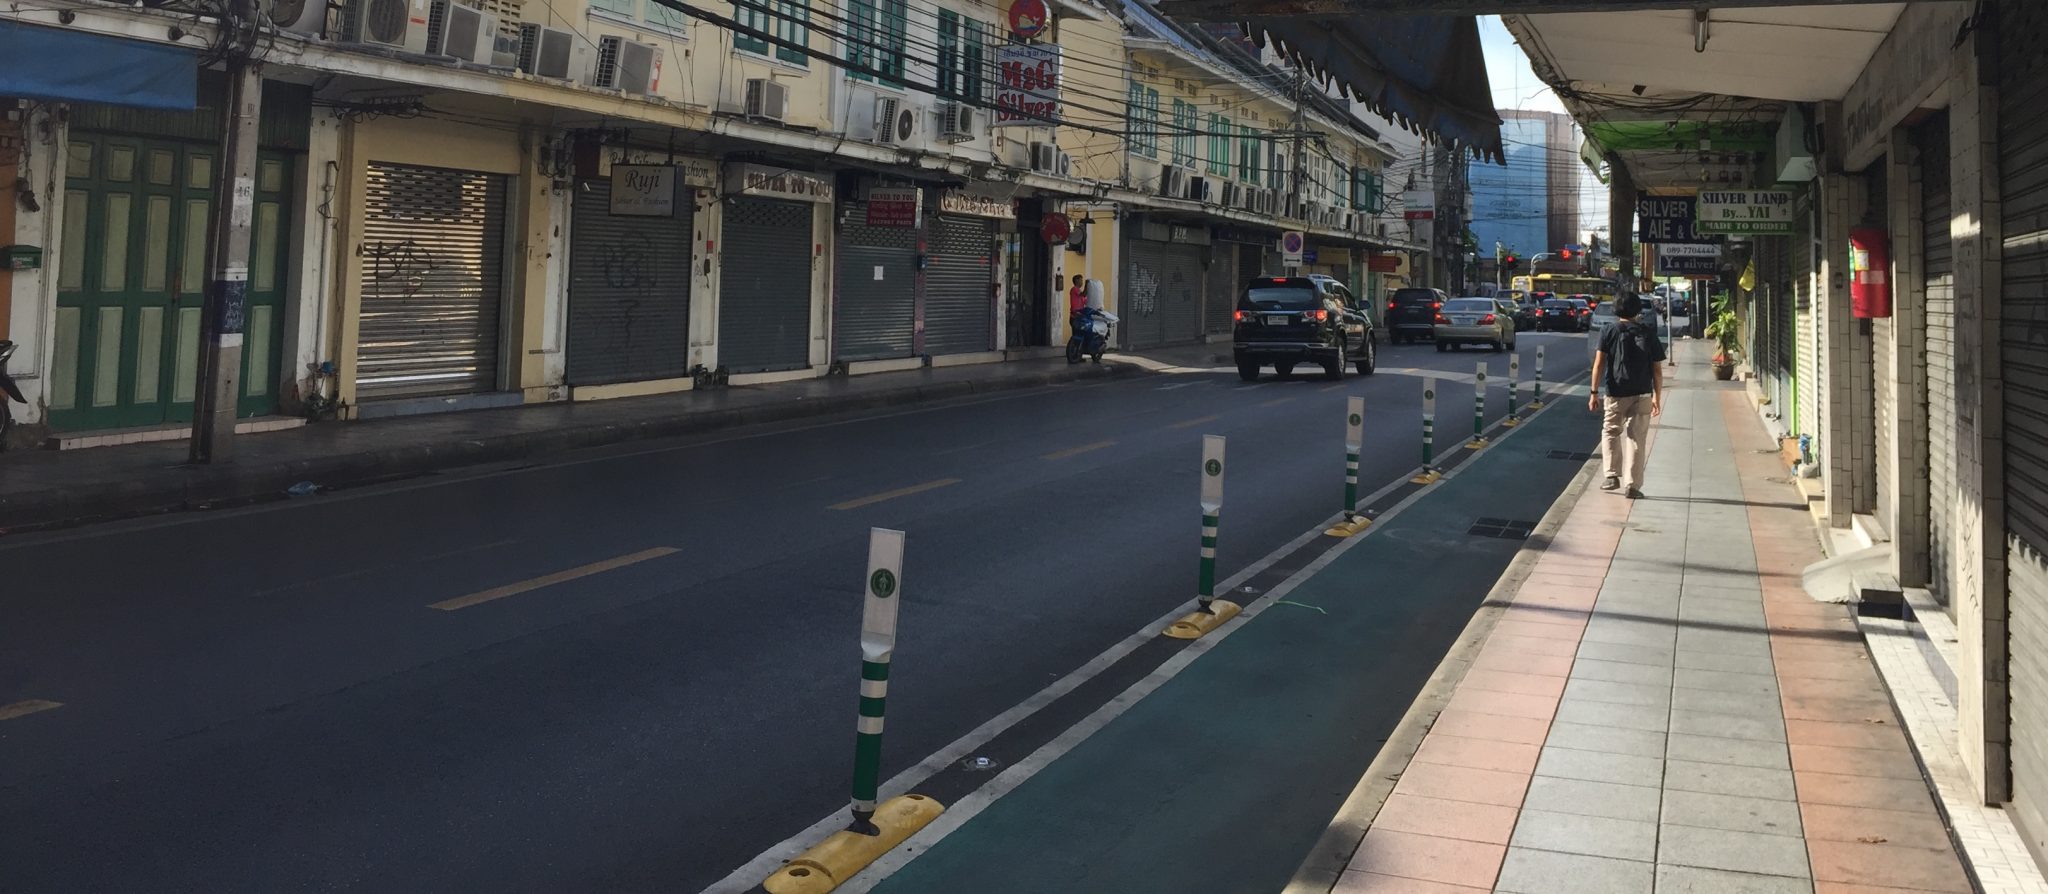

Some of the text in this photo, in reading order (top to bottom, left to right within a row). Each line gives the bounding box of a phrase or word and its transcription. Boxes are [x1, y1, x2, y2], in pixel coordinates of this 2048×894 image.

[998, 92, 1055, 121] Silver
[748, 173, 831, 198] SILVER TO YOU
[1703, 193, 1788, 204] SILVER LAND
[1640, 200, 1688, 218] SILVER
[1648, 219, 1671, 239] AIE
[1677, 224, 1685, 239] &
[1736, 222, 1749, 230] TO
[1752, 222, 1788, 230] ORDER
[1666, 246, 1715, 254] 089-7704444
[1665, 256, 1715, 269] Ya silver
